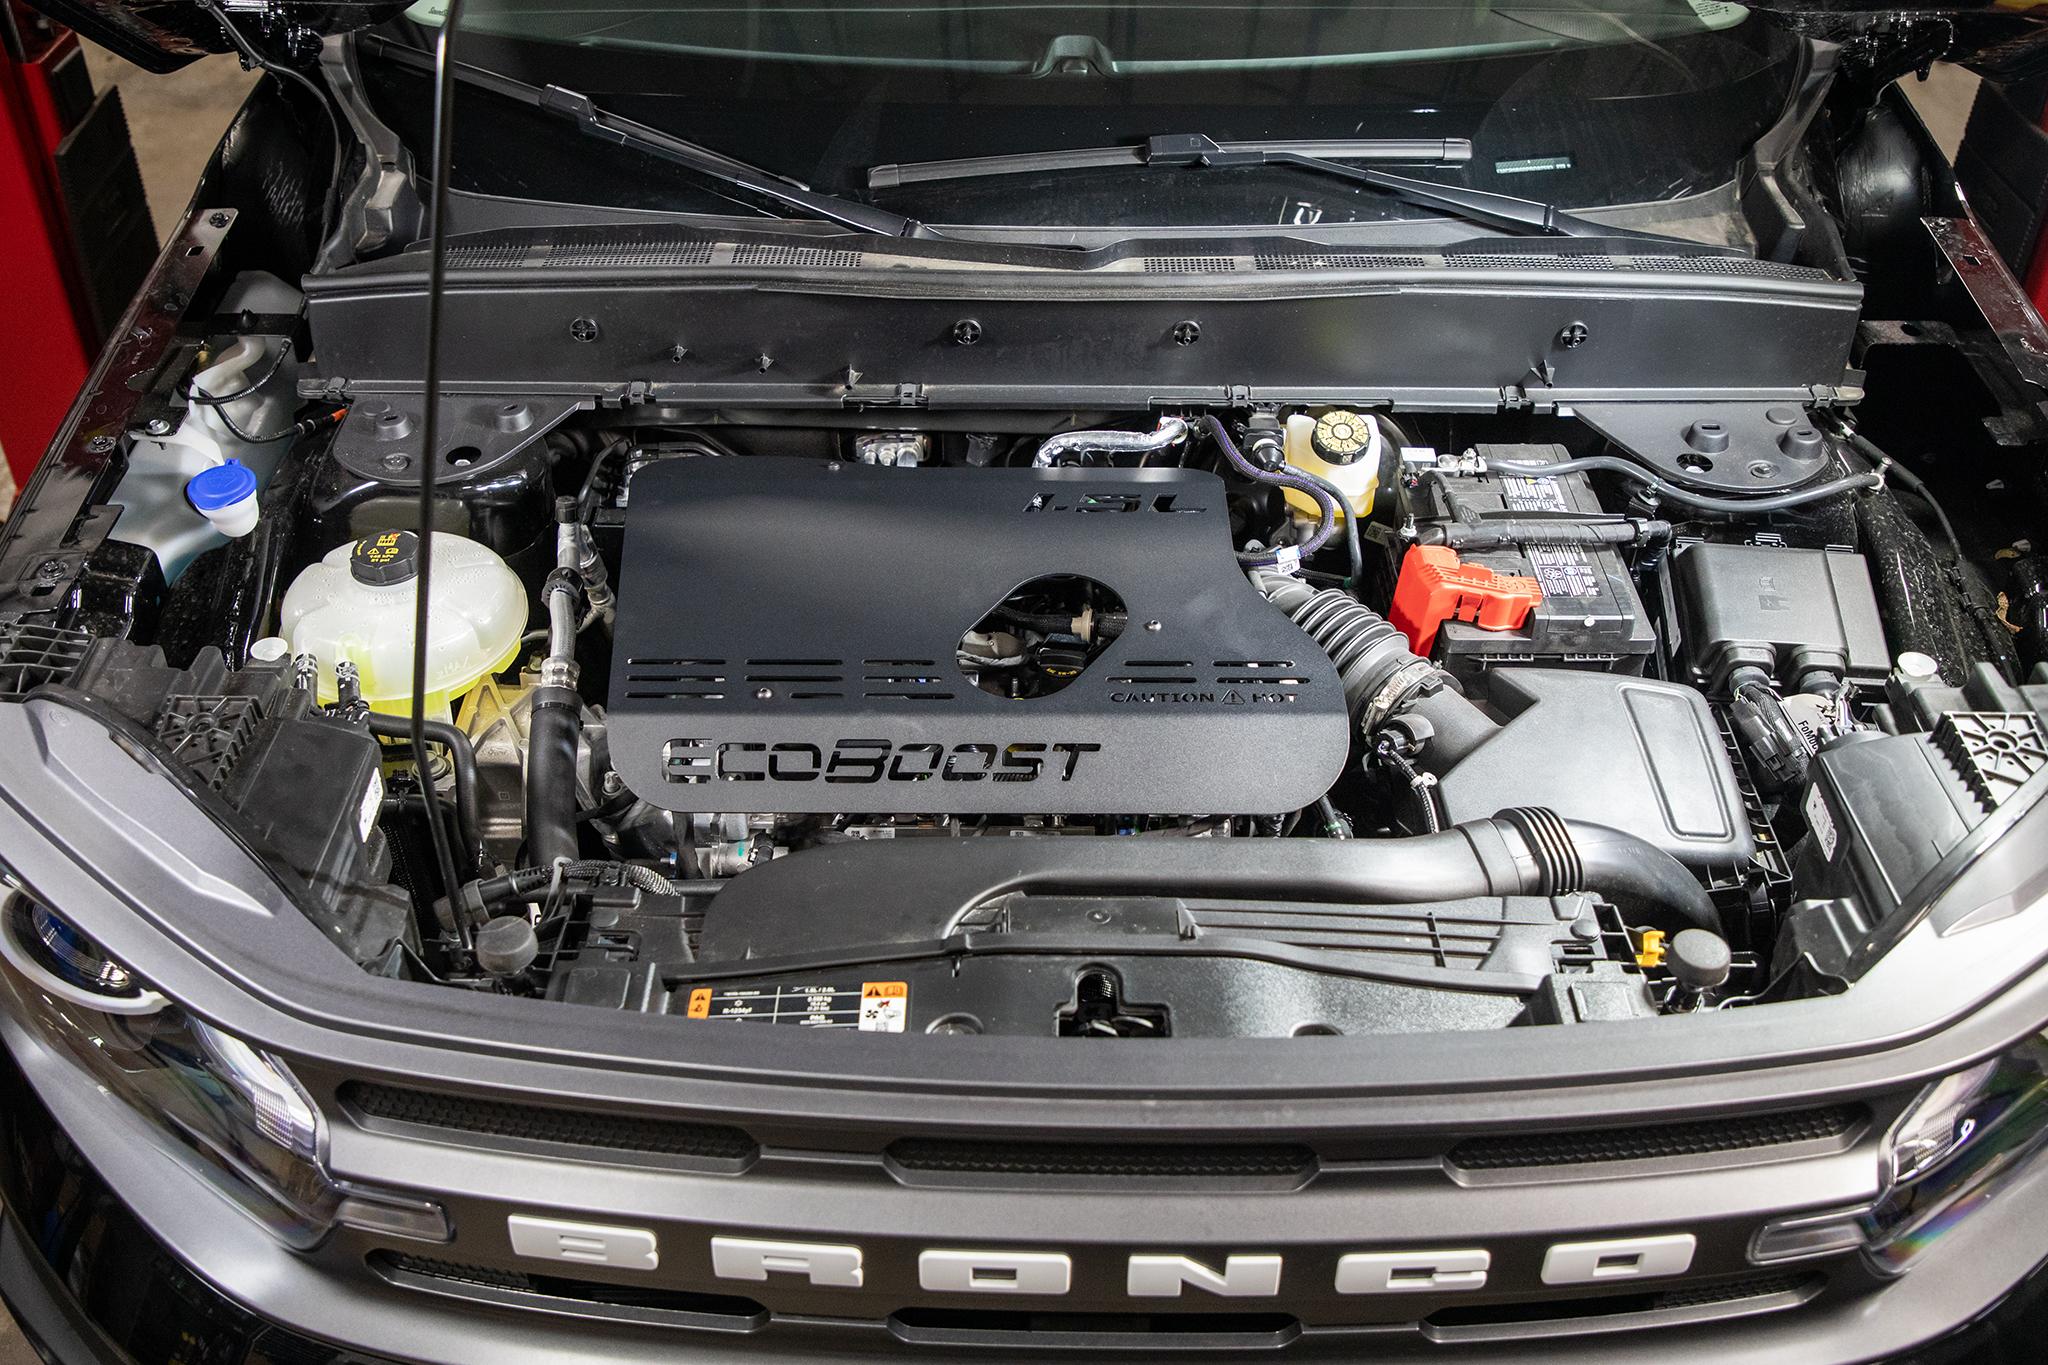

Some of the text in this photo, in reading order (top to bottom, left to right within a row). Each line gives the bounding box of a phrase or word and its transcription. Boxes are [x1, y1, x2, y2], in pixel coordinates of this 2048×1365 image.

[1023, 492, 1207, 512] 1.5L
[1110, 692, 1298, 703] CAUTION HOT
[507, 1214, 1698, 1297] BRONCO
